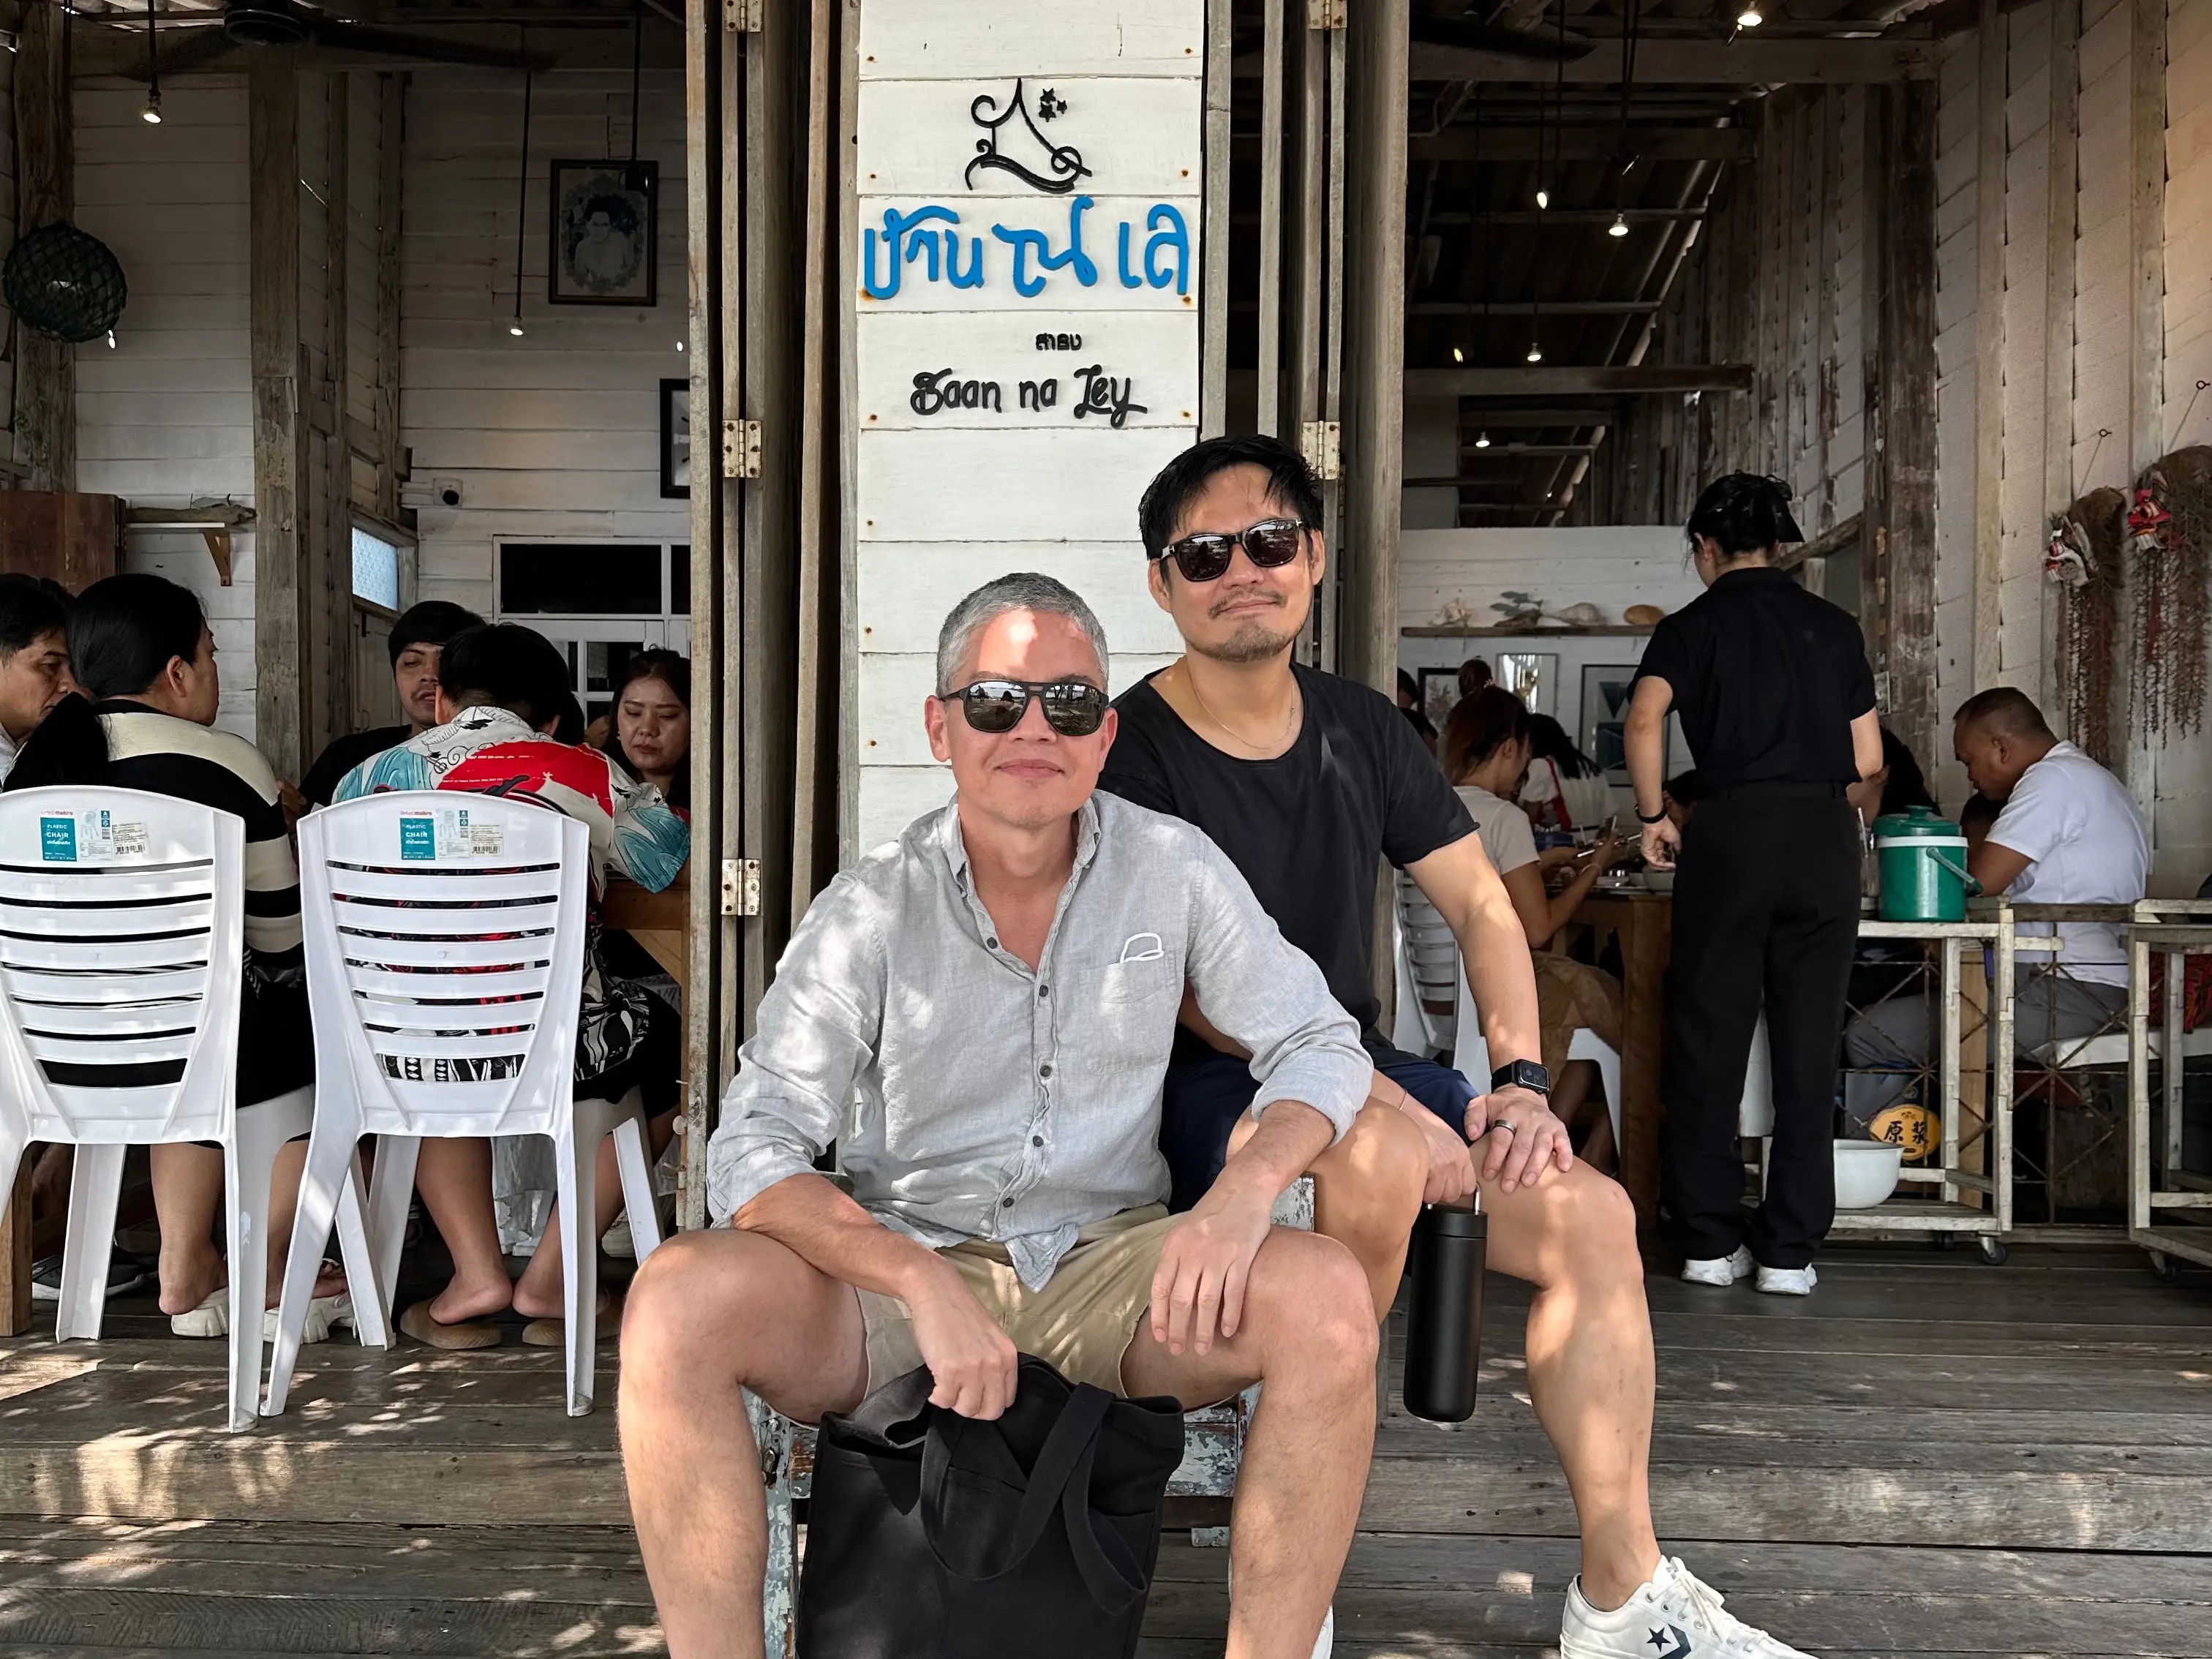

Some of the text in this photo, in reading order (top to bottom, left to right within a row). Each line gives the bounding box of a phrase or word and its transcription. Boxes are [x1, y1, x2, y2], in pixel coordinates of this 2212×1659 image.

[863, 195, 1189, 301] บ้าน ณ เล
[1018, 377, 1058, 413] na
